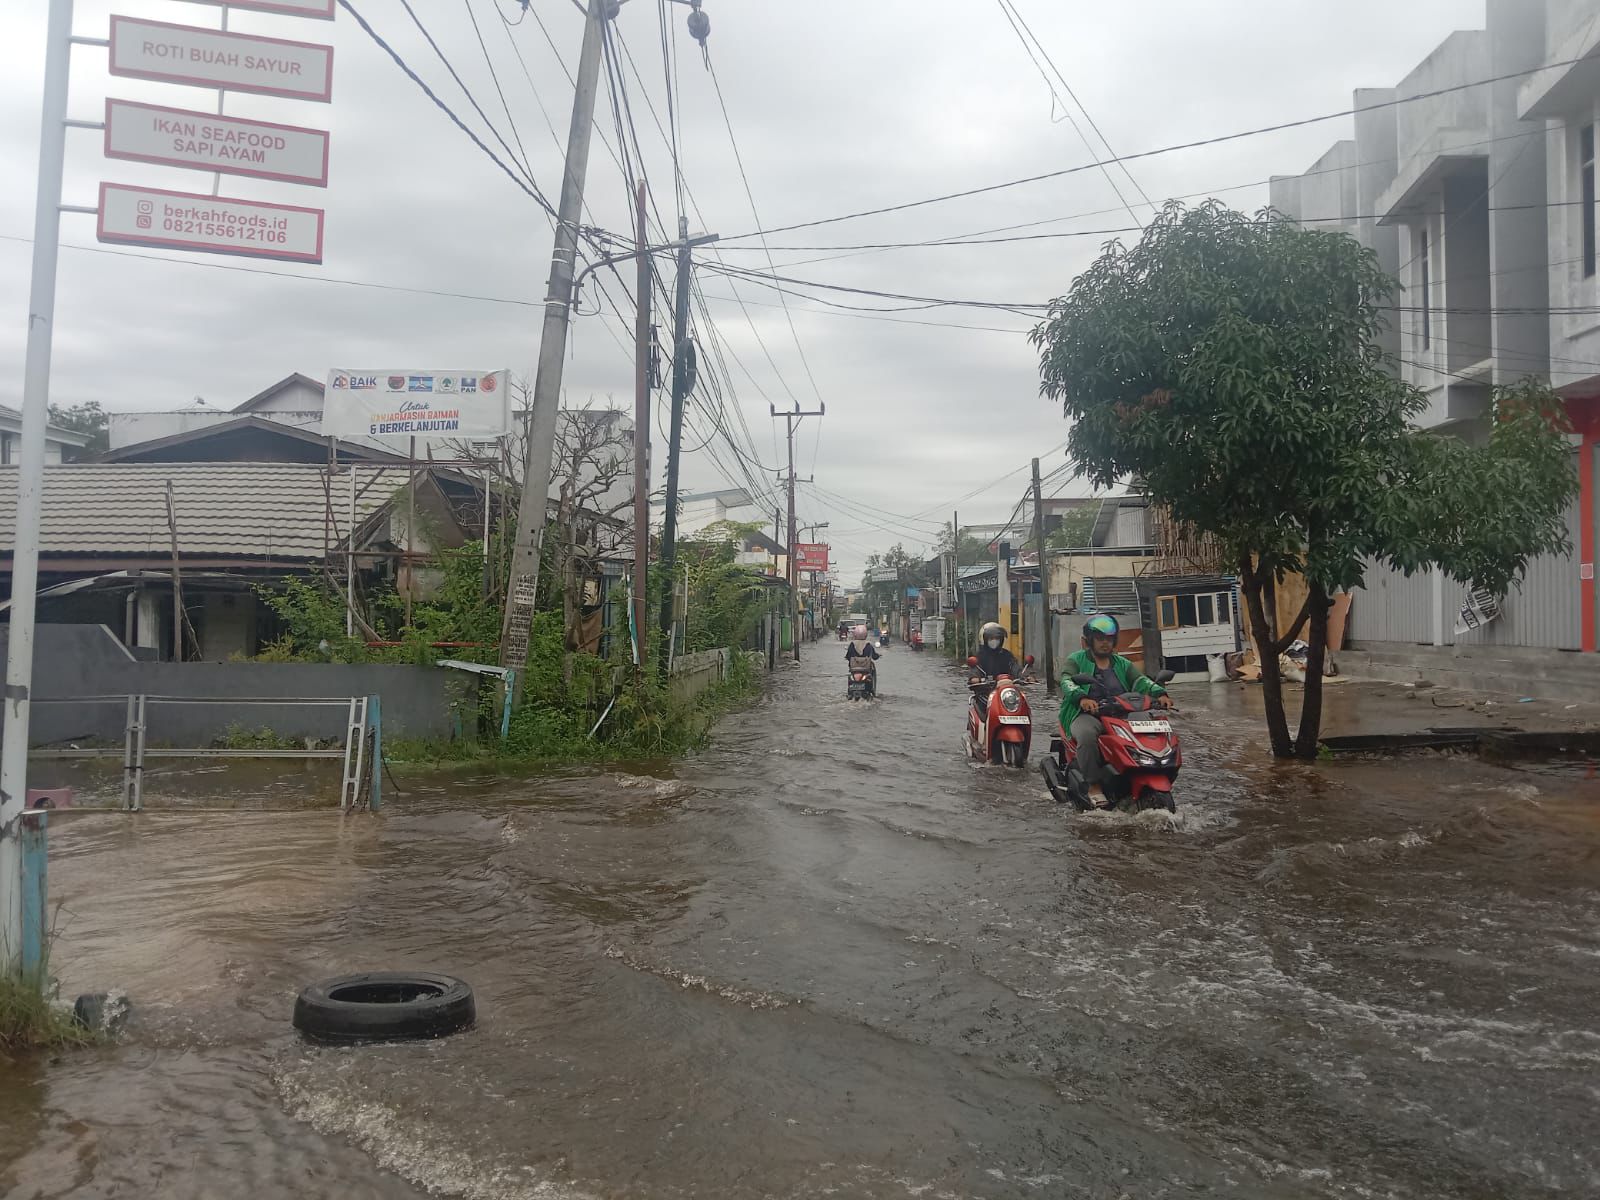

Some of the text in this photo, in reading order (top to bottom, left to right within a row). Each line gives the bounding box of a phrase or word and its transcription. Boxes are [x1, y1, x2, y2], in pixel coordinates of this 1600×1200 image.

[143, 41, 302, 76] ROTI BUAH SAYUR
[153, 118, 286, 151] IKAN SEAFOOD
[173, 138, 265, 163] SAPI AYAM
[163, 203, 288, 230] berkahfoods.id
[163, 218, 287, 243] 082155612106
[350, 376, 377, 386] BAIK
[370, 409, 459, 423] BANJARMASIN BAIMAN
[399, 401, 430, 413] Untuk
[379, 420, 459, 434] BERKELANJUTAN
